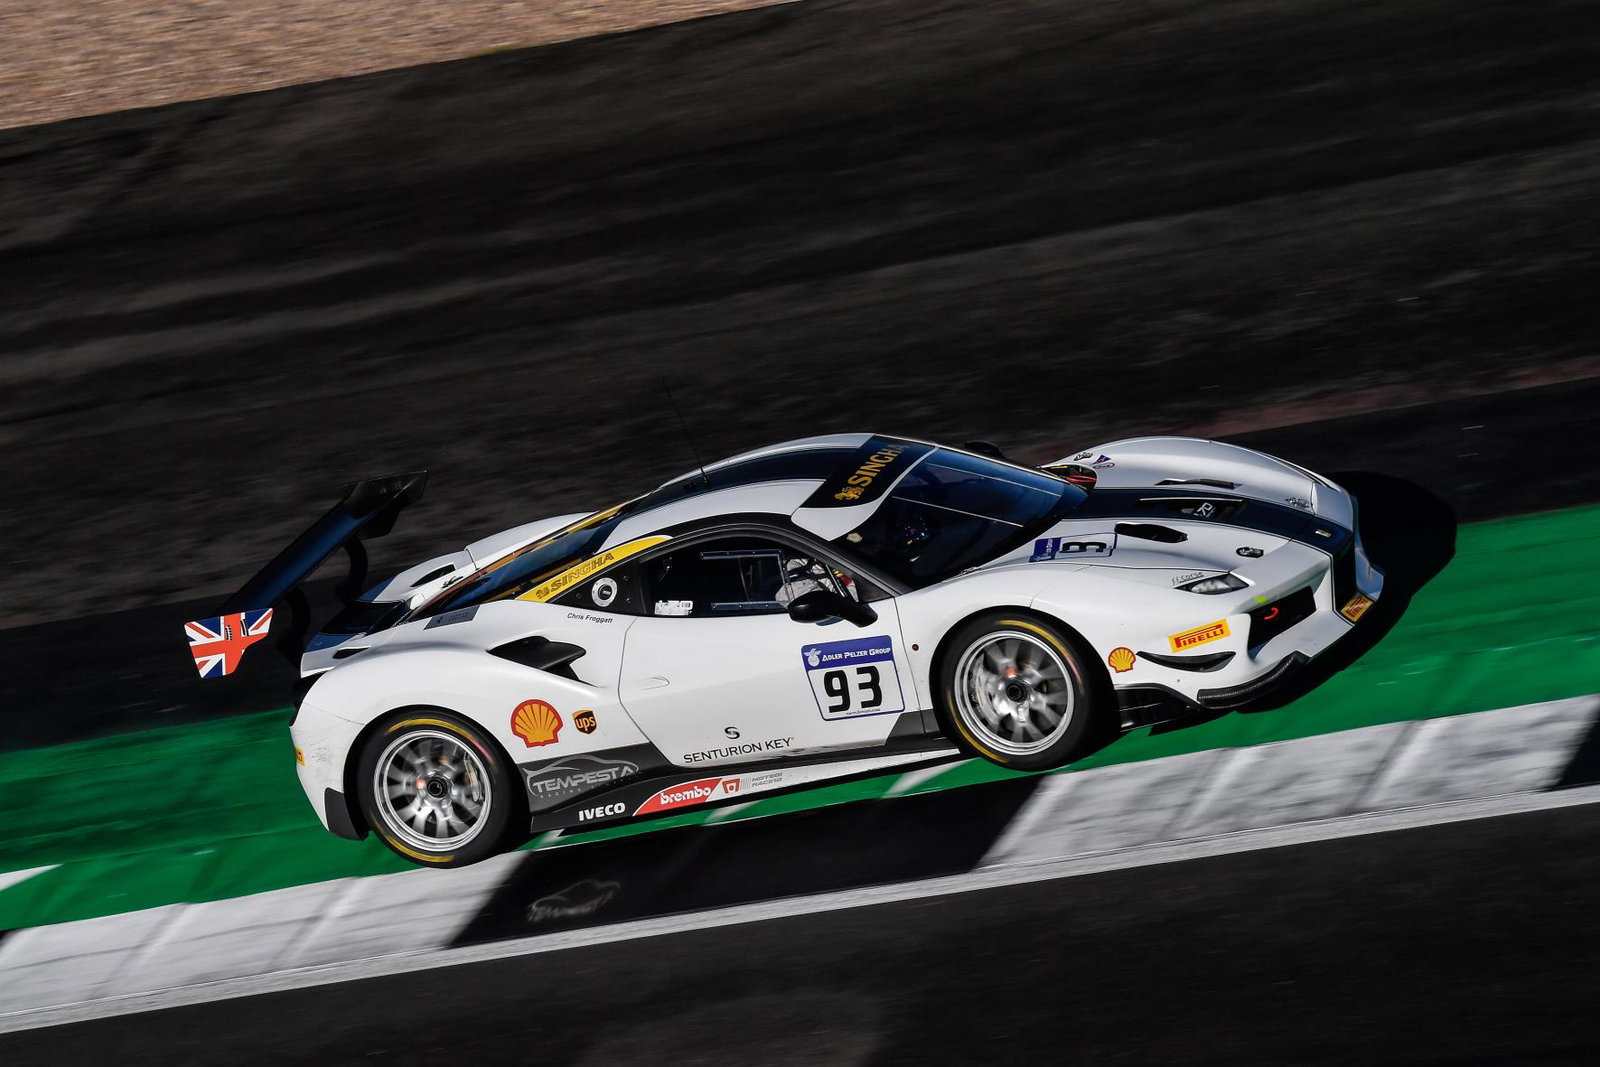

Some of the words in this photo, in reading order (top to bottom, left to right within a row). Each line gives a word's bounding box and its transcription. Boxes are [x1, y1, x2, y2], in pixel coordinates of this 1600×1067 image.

[550, 552, 615, 593] SINGHA
[567, 612, 584, 620] Chris
[585, 615, 613, 624] Froggatt
[1174, 623, 1225, 648] PIRELLI
[823, 665, 883, 713] 93
[575, 716, 596, 732] ups
[683, 742, 762, 764] SENTURION
[764, 737, 791, 751] KEY
[532, 765, 635, 793] TEMPESTA
[660, 785, 711, 805] brembo
[578, 802, 626, 821] IVECO
